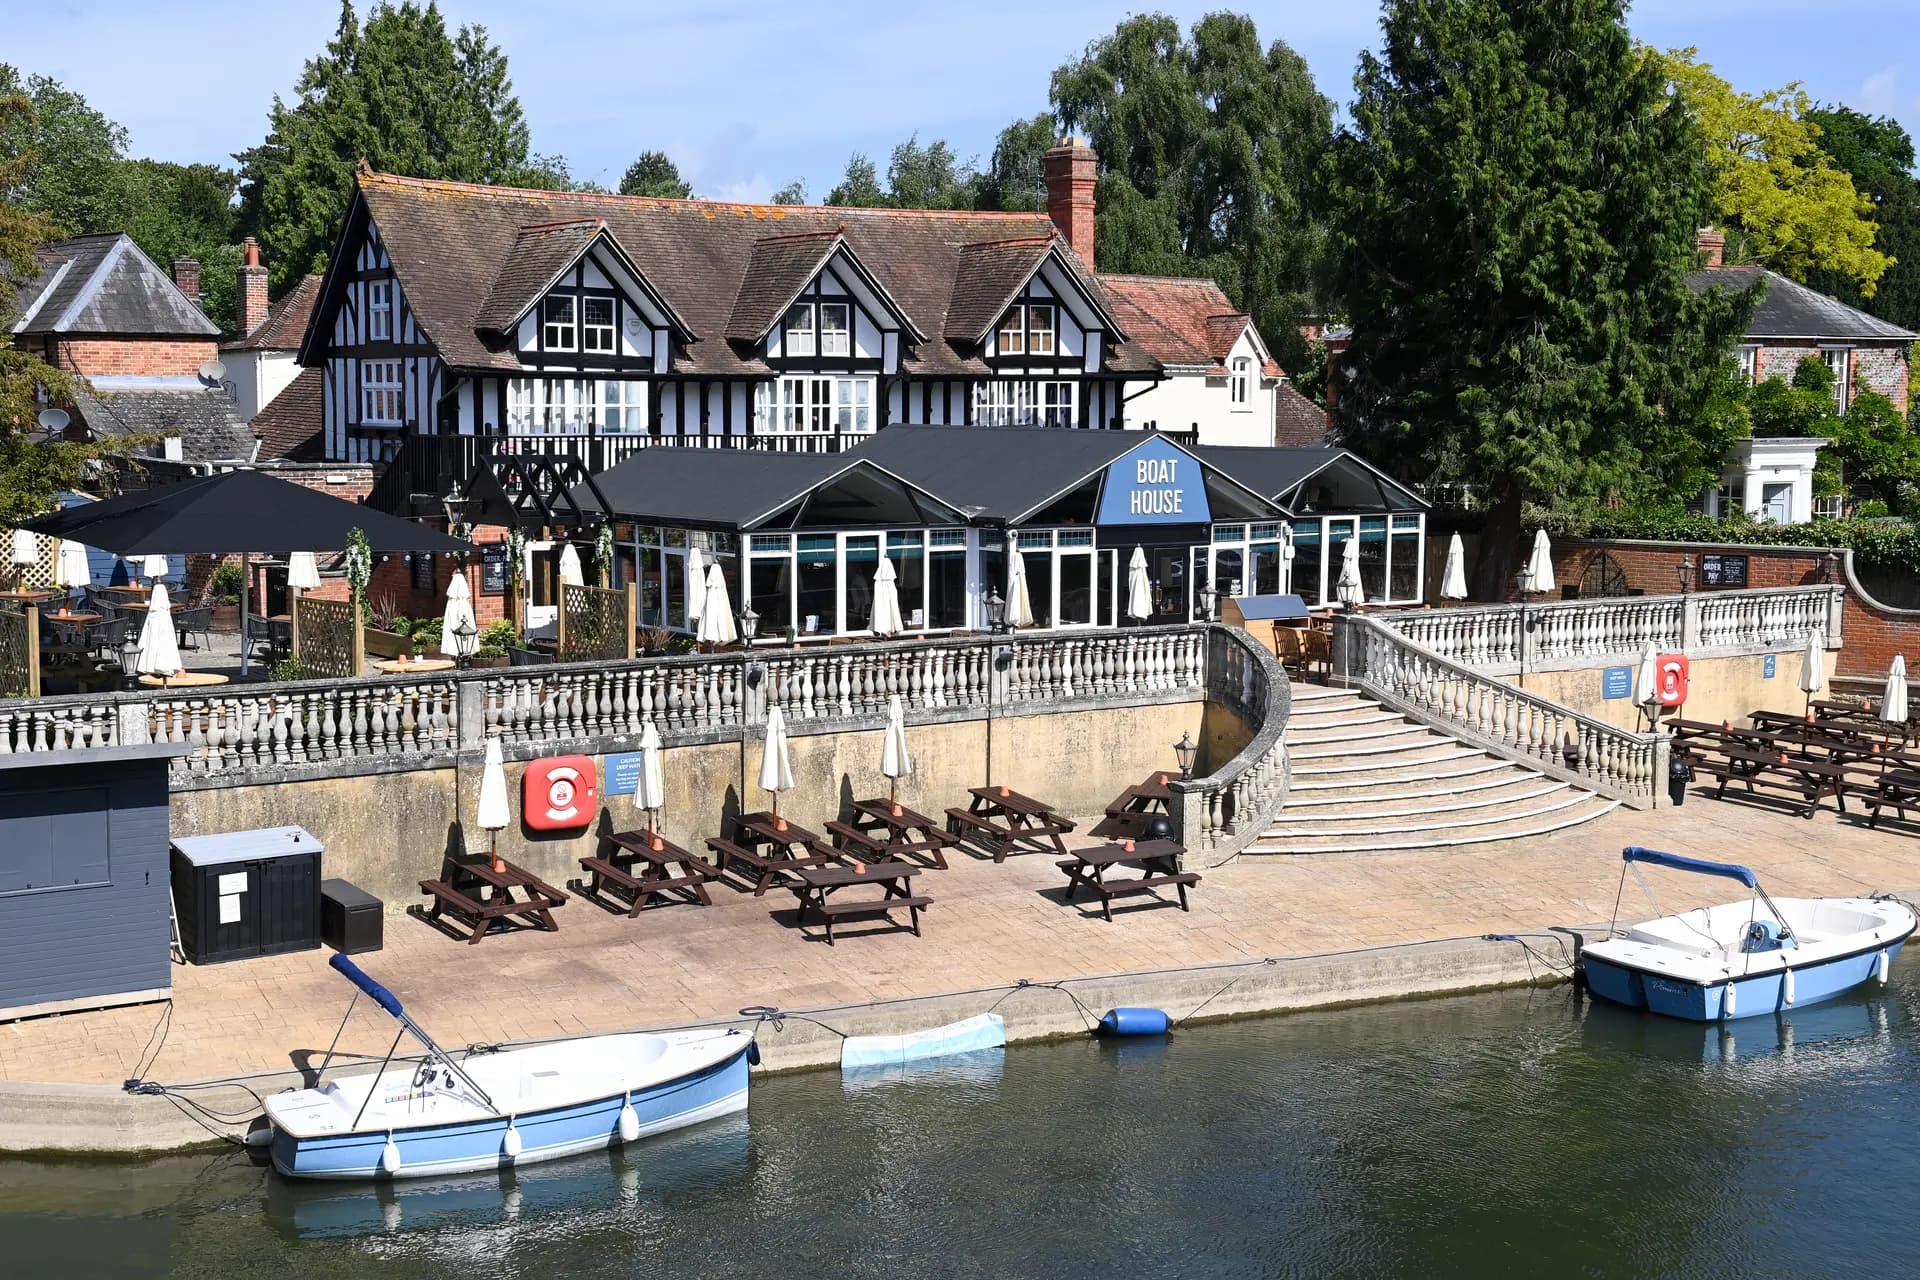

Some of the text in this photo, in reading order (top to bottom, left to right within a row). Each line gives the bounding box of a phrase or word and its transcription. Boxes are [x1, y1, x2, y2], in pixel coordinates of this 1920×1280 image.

[1137, 459, 1178, 484] BOAT
[1131, 489, 1183, 515] HOUSE
[1703, 563, 1721, 571] ORDER
[1708, 572, 1719, 580] PAY
